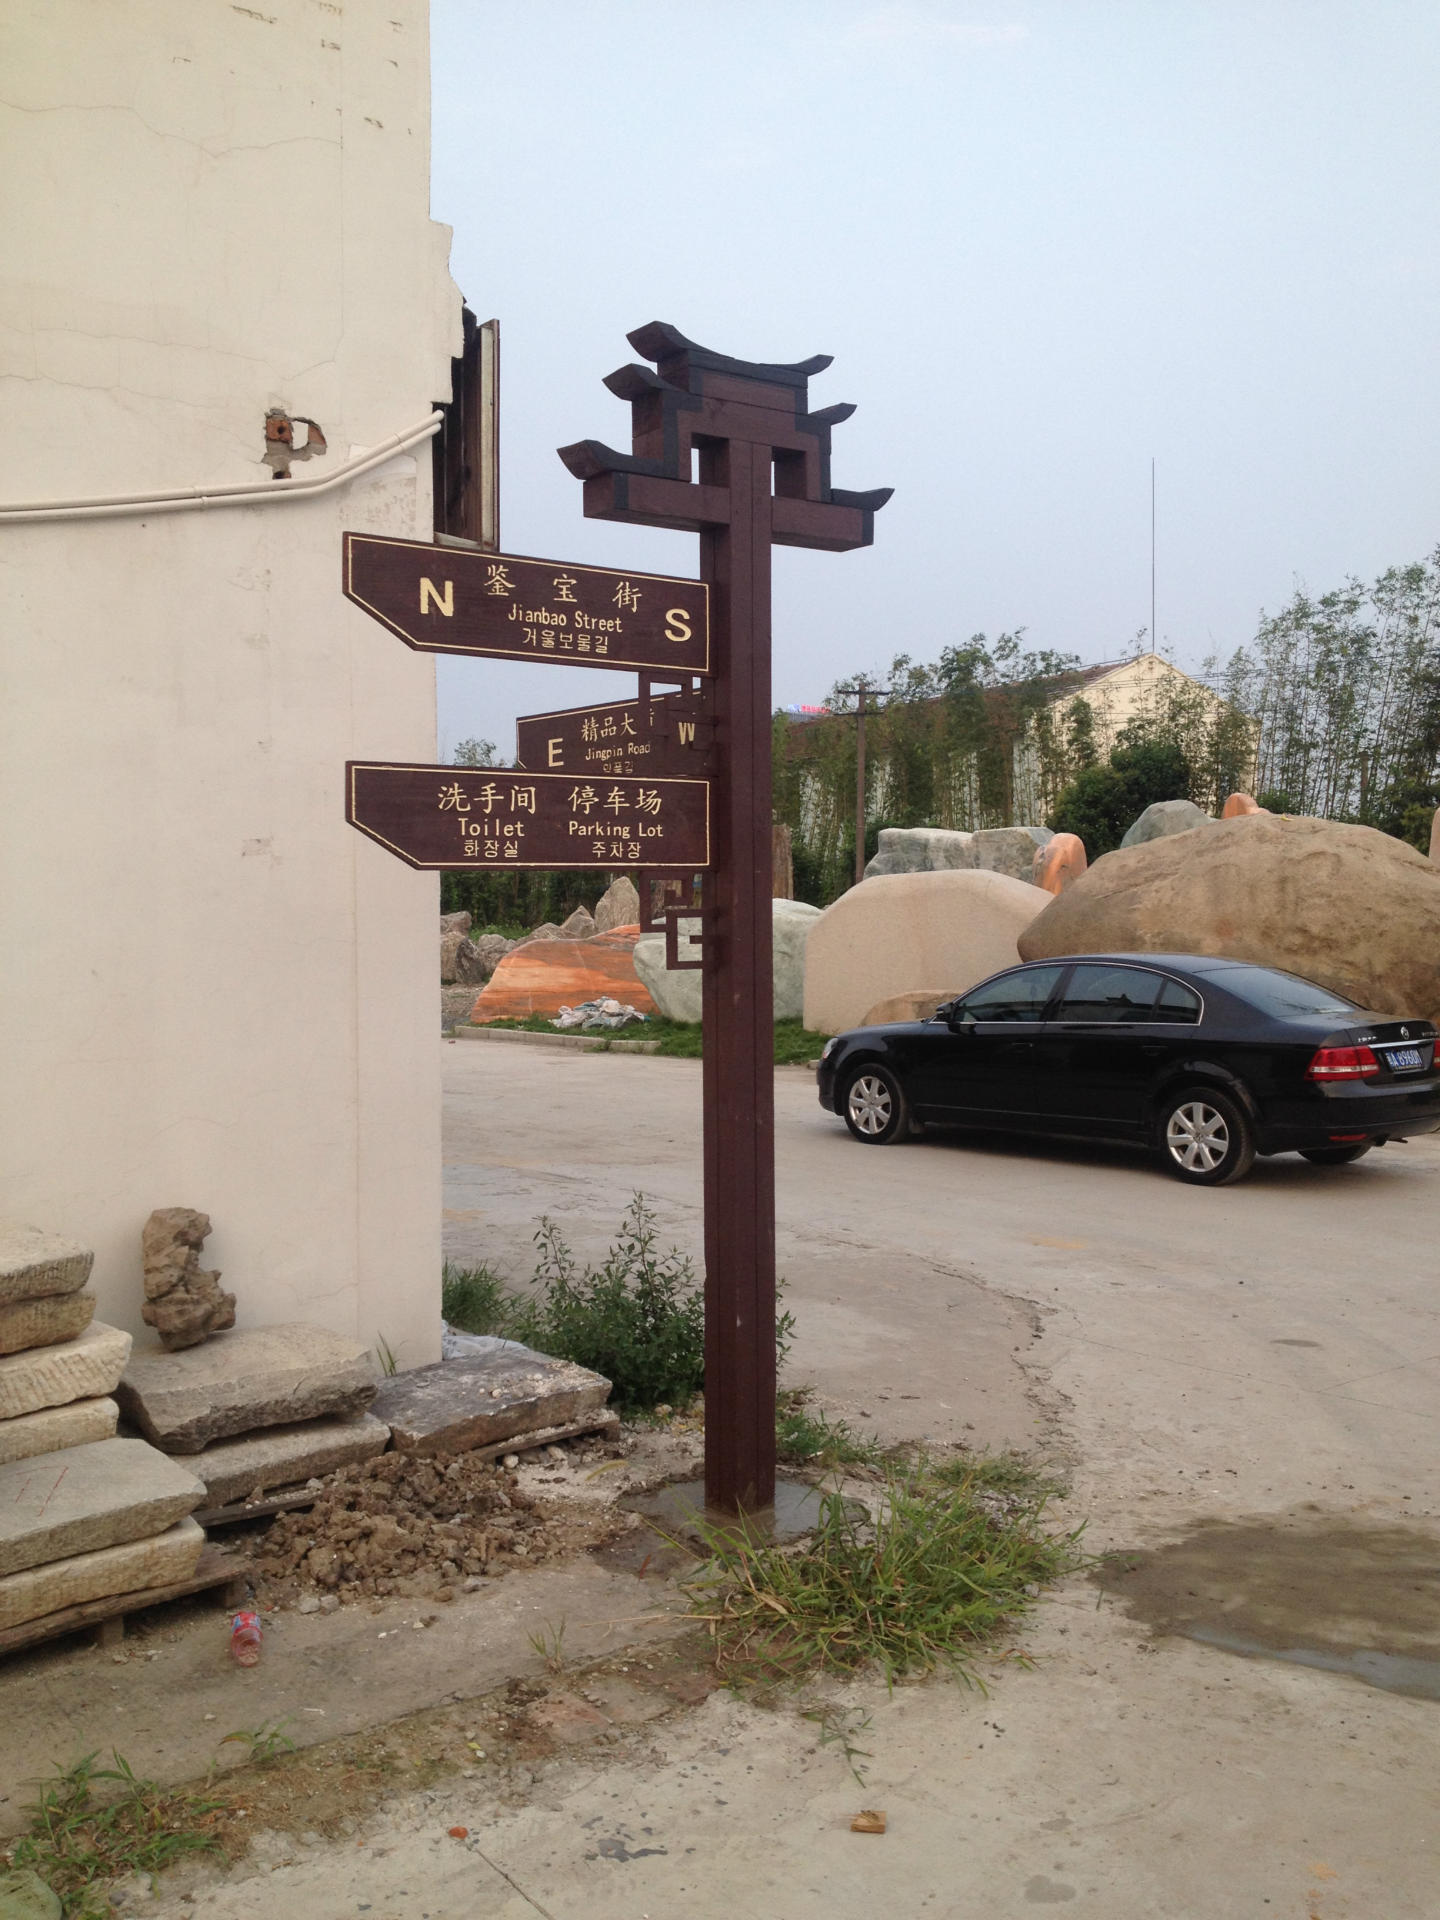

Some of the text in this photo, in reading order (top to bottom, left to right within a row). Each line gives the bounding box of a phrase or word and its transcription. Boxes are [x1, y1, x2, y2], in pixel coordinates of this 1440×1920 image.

[419, 577, 455, 617] N
[483, 564, 643, 614] 鉴宝街
[507, 603, 623, 633] Jianbao Street
[664, 608, 693, 642] S
[522, 627, 609, 654] 거울보물길
[678, 721, 695, 745] W
[548, 737, 565, 768] E
[585, 741, 651, 762] Jingpin Road
[437, 782, 537, 815] 洗手间
[567, 785, 663, 816] 停车场
[457, 817, 525, 838] Toilet
[568, 821, 664, 840] Parking Lot
[463, 839, 520, 859] 화장실
[591, 841, 642, 859] 주차장
